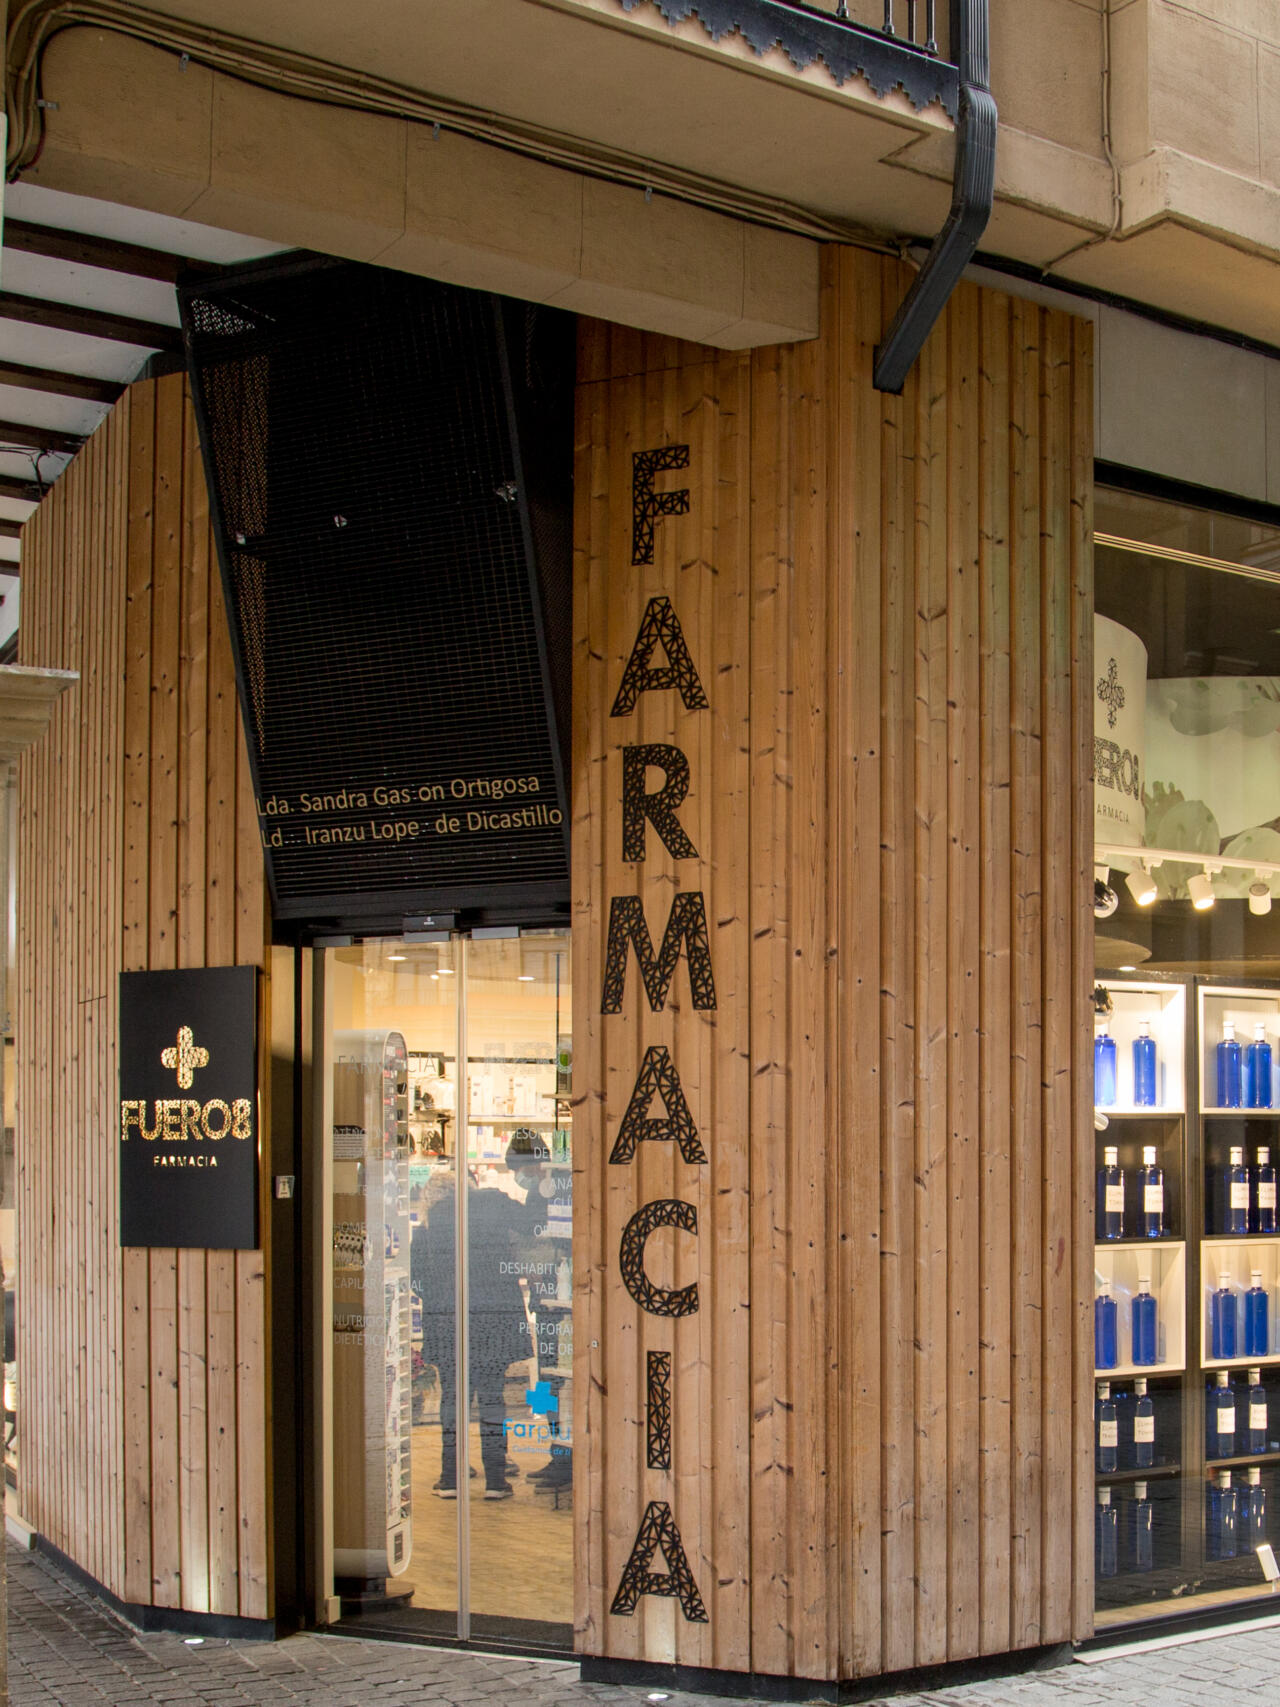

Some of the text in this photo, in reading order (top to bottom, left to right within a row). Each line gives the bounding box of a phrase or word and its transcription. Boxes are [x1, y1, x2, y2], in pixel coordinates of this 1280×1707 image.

[256, 795, 295, 816] Lda.
[300, 788, 368, 813] Sandra
[451, 775, 540, 800] Ortigosa
[305, 825, 366, 846] Iranzu
[436, 812, 460, 834] de
[467, 804, 563, 832] Dicastillo
[600, 445, 718, 1623] FARMACIA
[121, 1098, 251, 1141] FUERO8
[153, 1156, 218, 1167] FARMACIA
[540, 1342, 555, 1355] DE
